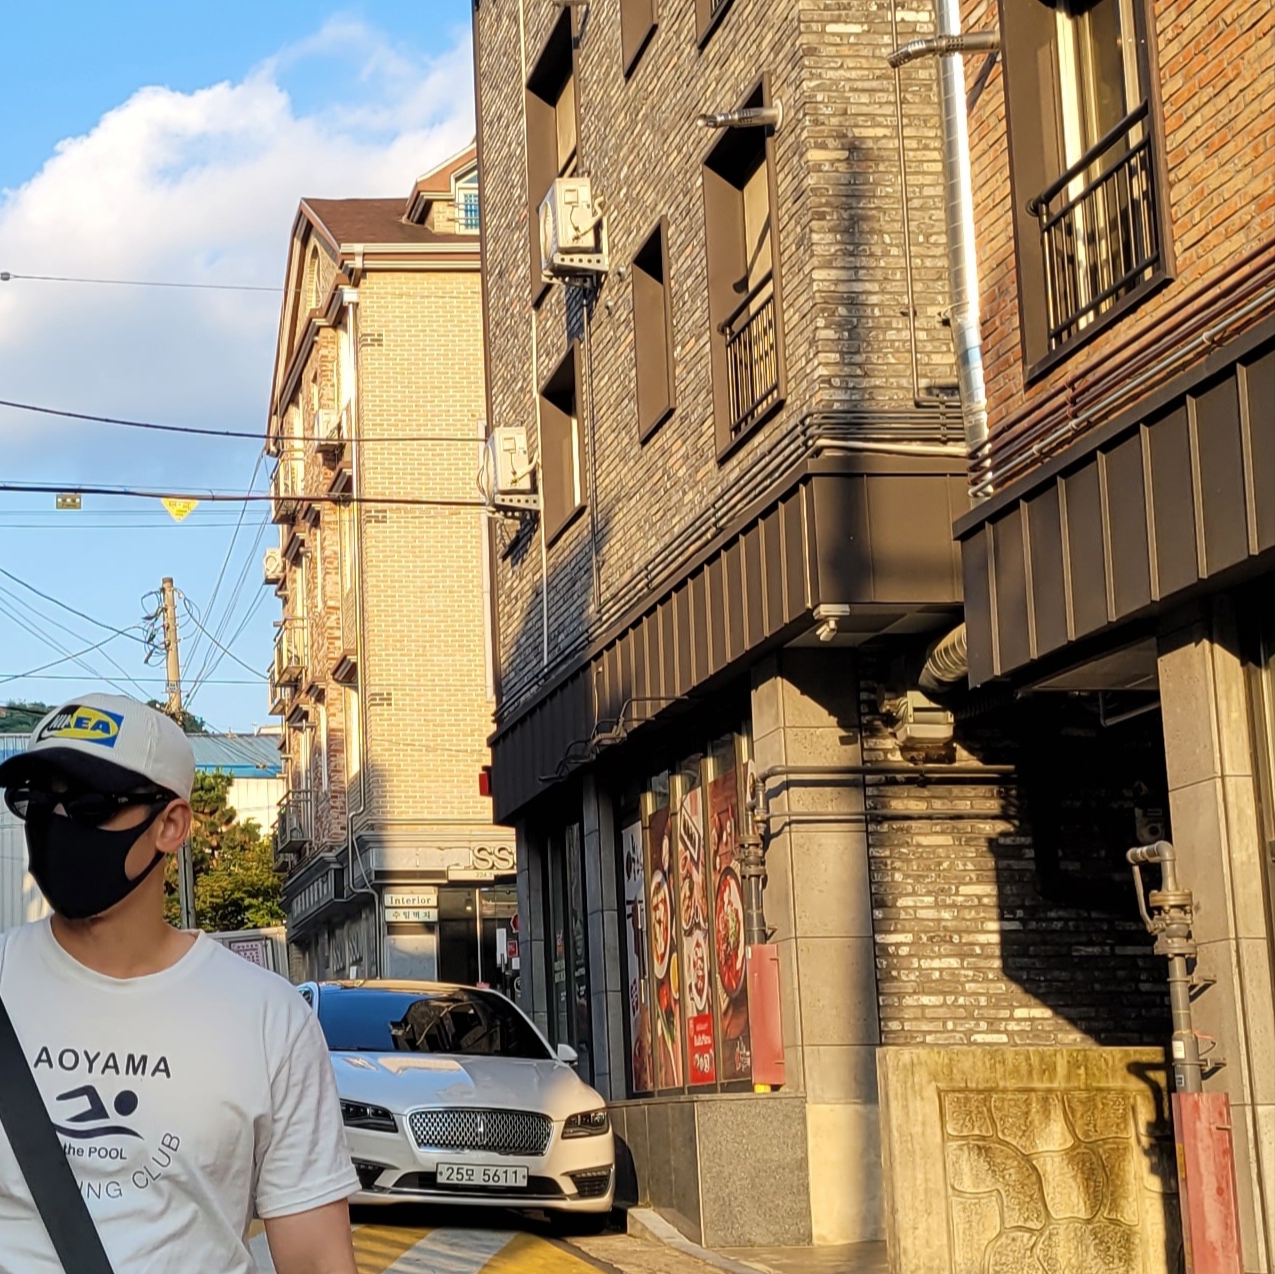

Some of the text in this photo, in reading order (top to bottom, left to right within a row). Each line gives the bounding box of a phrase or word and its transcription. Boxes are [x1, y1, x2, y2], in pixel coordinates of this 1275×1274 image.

[473, 844, 516, 870] SS
[390, 896, 431, 904] Interior
[33, 1046, 171, 1079] AOYAMA
[63, 1143, 127, 1160] the POOL
[132, 1132, 180, 1189] CLUB
[445, 1166, 518, 1184] 25모 5611
